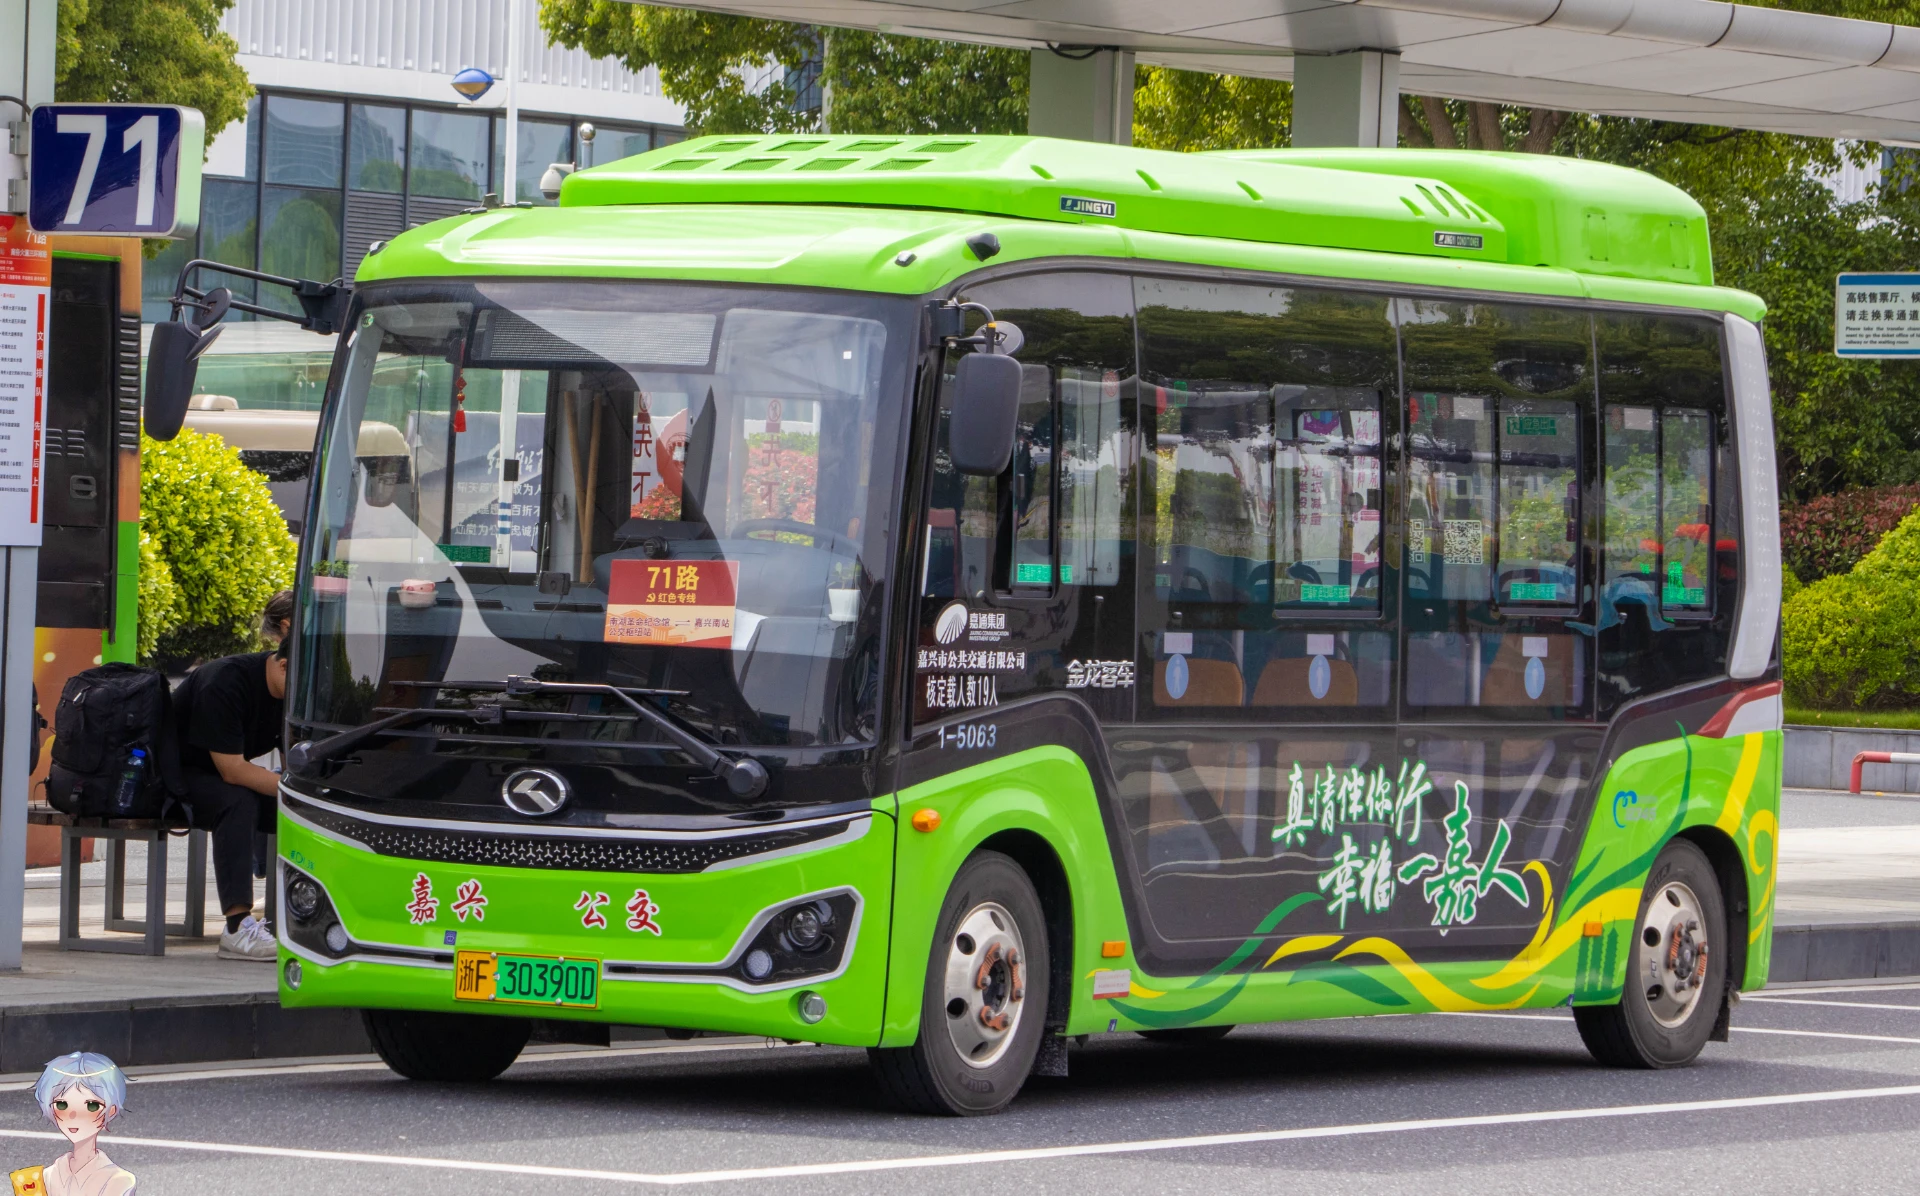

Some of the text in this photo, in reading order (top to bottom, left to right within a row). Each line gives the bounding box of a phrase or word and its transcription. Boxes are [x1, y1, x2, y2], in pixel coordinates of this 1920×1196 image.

[57, 114, 159, 226] 71
[1073, 200, 1111, 214] JINGYI
[1846, 309, 1919, 321] 请走换乘通道
[32, 331, 45, 487] 文明排队 先下后上
[647, 565, 699, 590] 71路
[658, 593, 696, 603] 红色专线
[608, 628, 653, 637] 公交枢纽站
[609, 617, 730, 628] 南湖革命纪念馆 嘉兴南站
[969, 613, 1005, 629] 嘉通集团
[917, 650, 1025, 669] 嘉兴市公共交通有限公司
[1065, 659, 1134, 688] 金龙客车
[926, 675, 998, 708] 核定载人数19人
[938, 724, 997, 749] 1-5063
[1271, 758, 1432, 847] 真情伴你行
[406, 872, 662, 936] 嘉兴 公交
[459, 958, 595, 1000] 浙F 30390D
